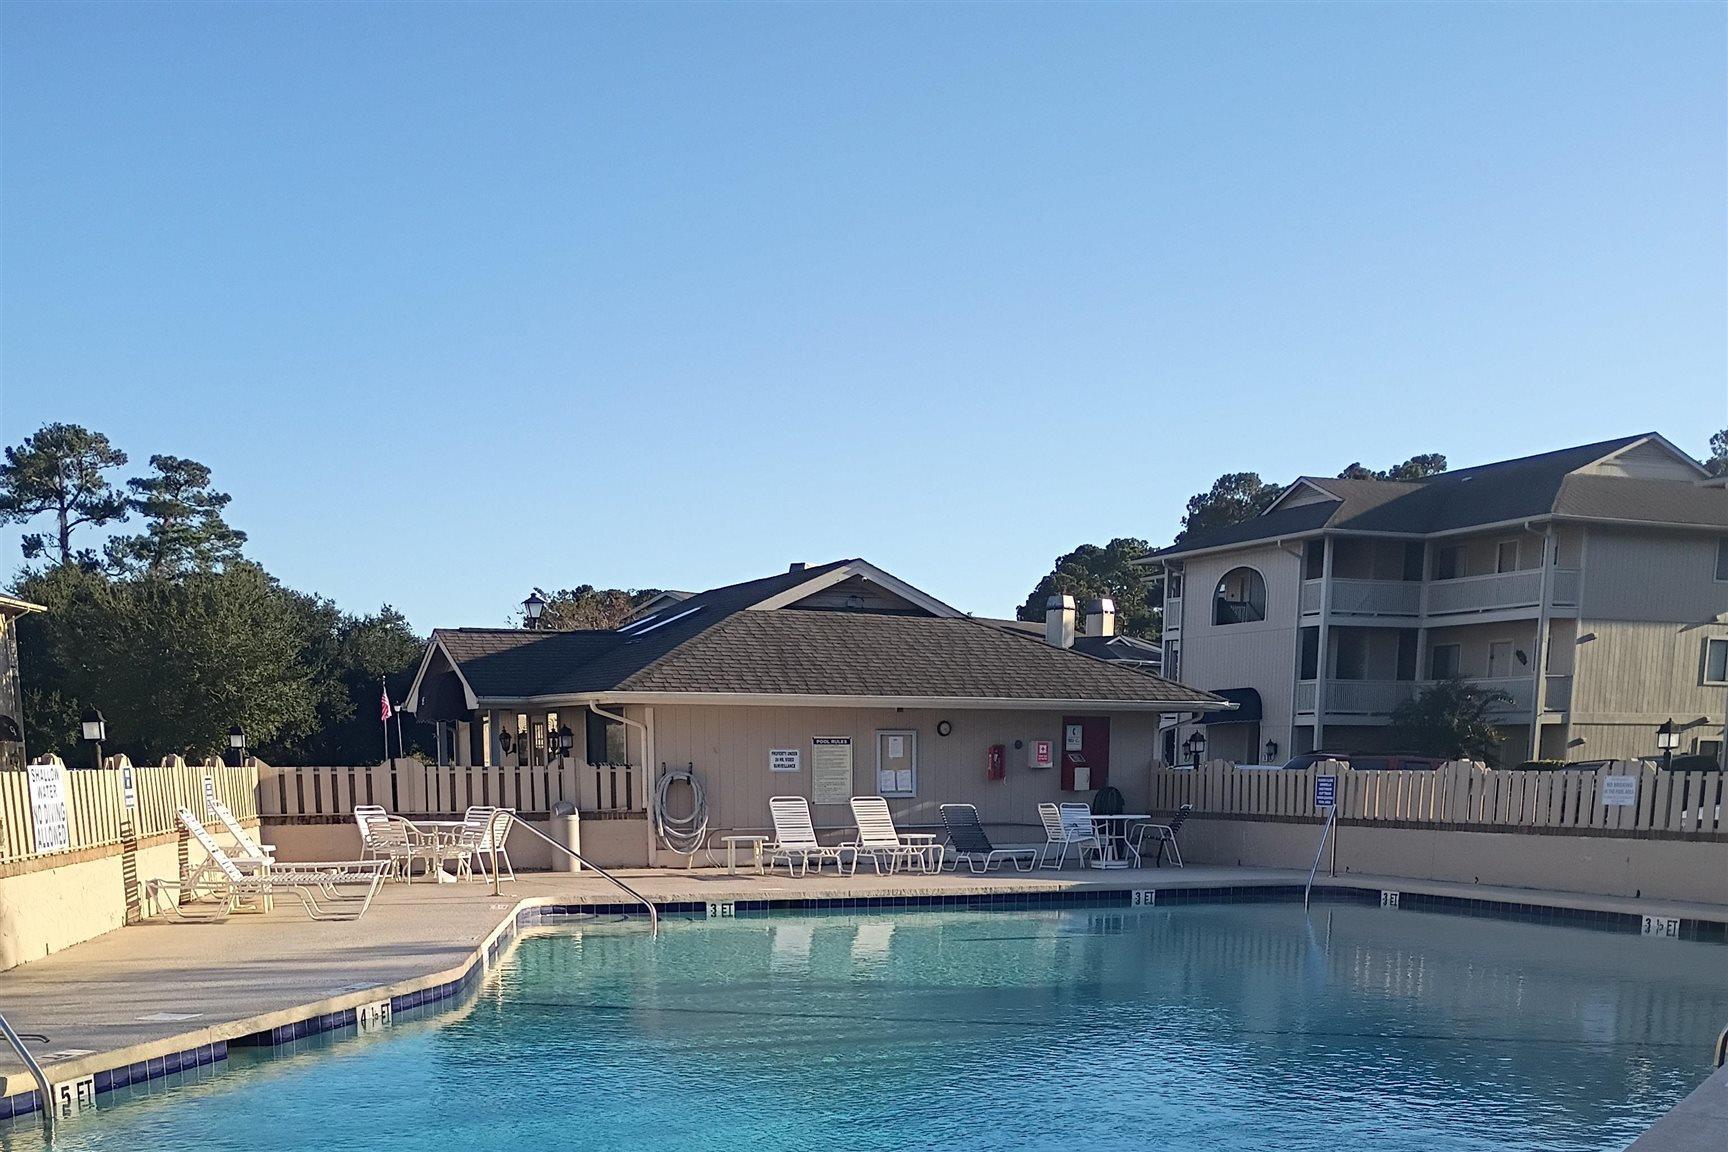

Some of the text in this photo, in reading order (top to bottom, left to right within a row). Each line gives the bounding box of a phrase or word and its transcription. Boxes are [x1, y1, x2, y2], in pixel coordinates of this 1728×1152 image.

[31, 768, 60, 782] SHALLOW
[37, 784, 58, 799] WATER
[33, 801, 66, 825] NO DIVING
[37, 824, 67, 849] ALLOWED
[1135, 891, 1141, 905] 3
[1382, 892, 1388, 906] 3
[710, 903, 717, 917] 3
[1644, 917, 1652, 934] 3
[60, 1079, 94, 1108] 5 FT
